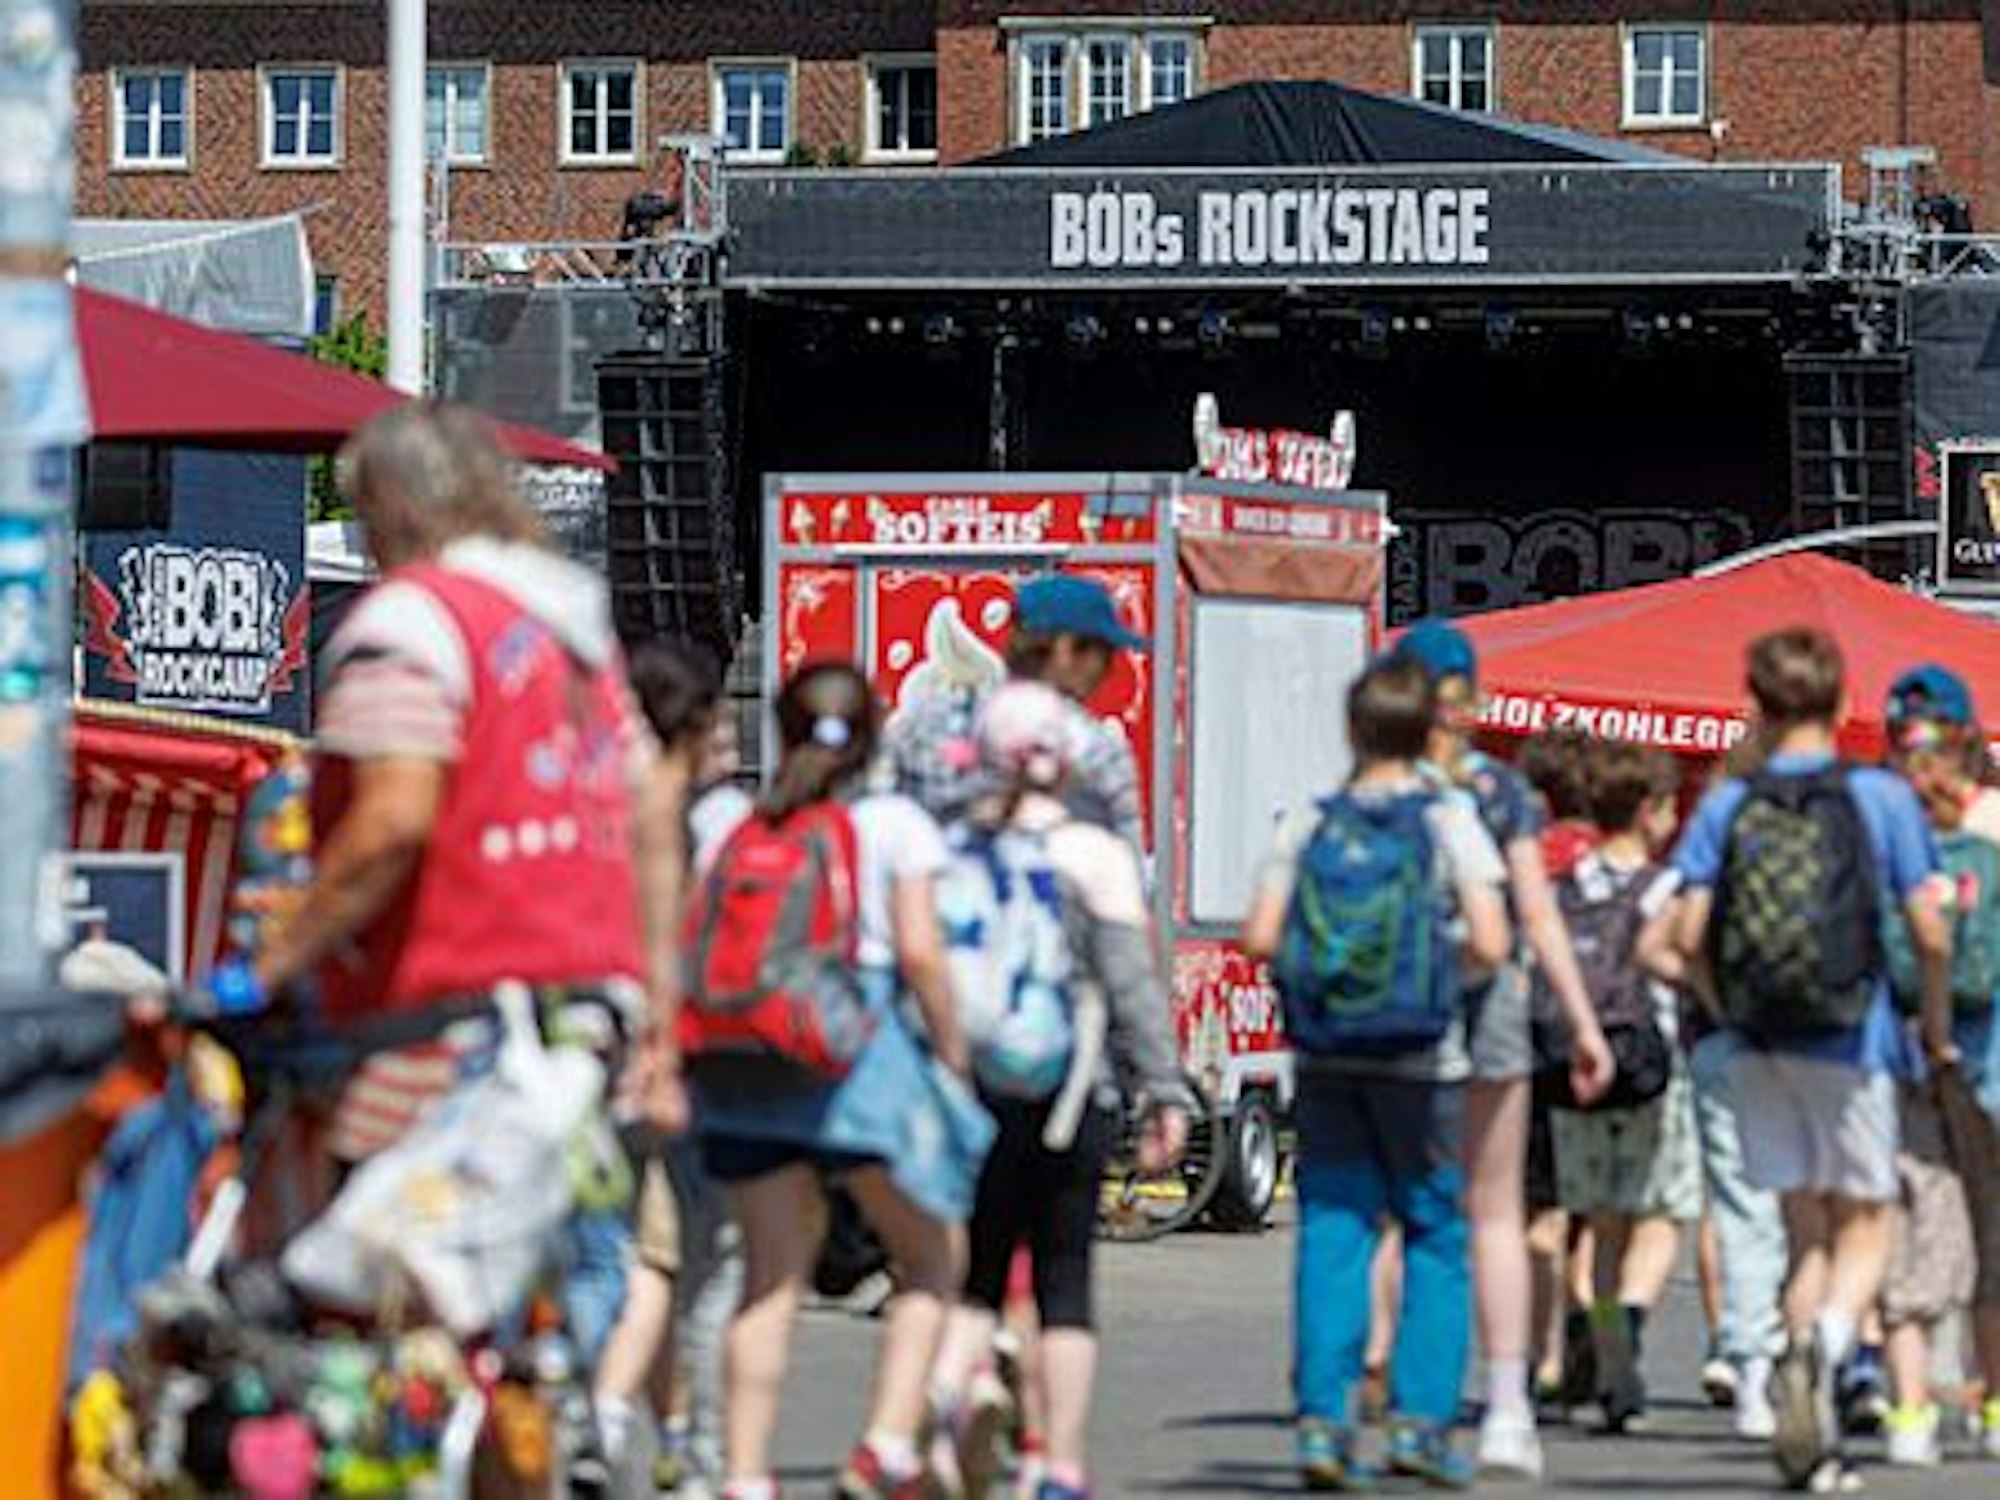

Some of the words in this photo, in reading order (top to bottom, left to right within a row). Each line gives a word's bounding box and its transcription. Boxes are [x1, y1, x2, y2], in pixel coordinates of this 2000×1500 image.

[1050, 191, 1184, 268] BOBs
[1199, 187, 1490, 266] ROCKSTAGE
[874, 510, 1044, 543] SOFTEIS
[143, 652, 268, 699] ROCKCAMP
